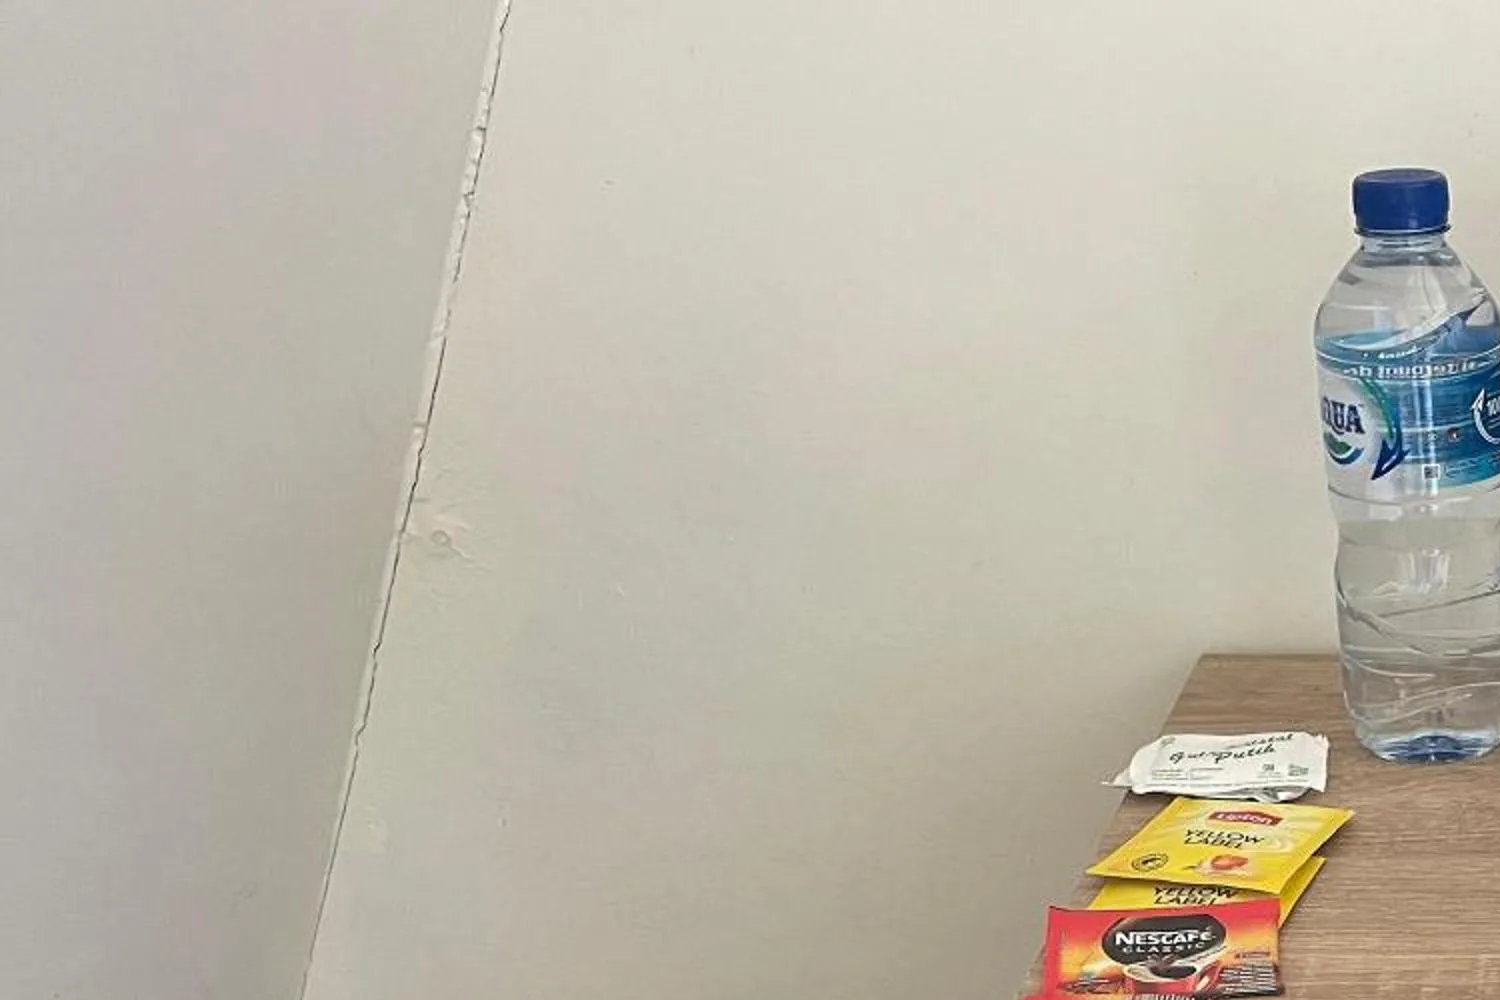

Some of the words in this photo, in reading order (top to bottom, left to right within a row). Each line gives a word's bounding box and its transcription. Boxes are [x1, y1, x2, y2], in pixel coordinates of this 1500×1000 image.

[1322, 396, 1366, 435] QUA
[1184, 837, 1243, 849] LABEL
[1185, 829, 1265, 844] YELLOW
[1153, 885, 1240, 899] YELLOW
[1122, 941, 1205, 955] CLASSIC
